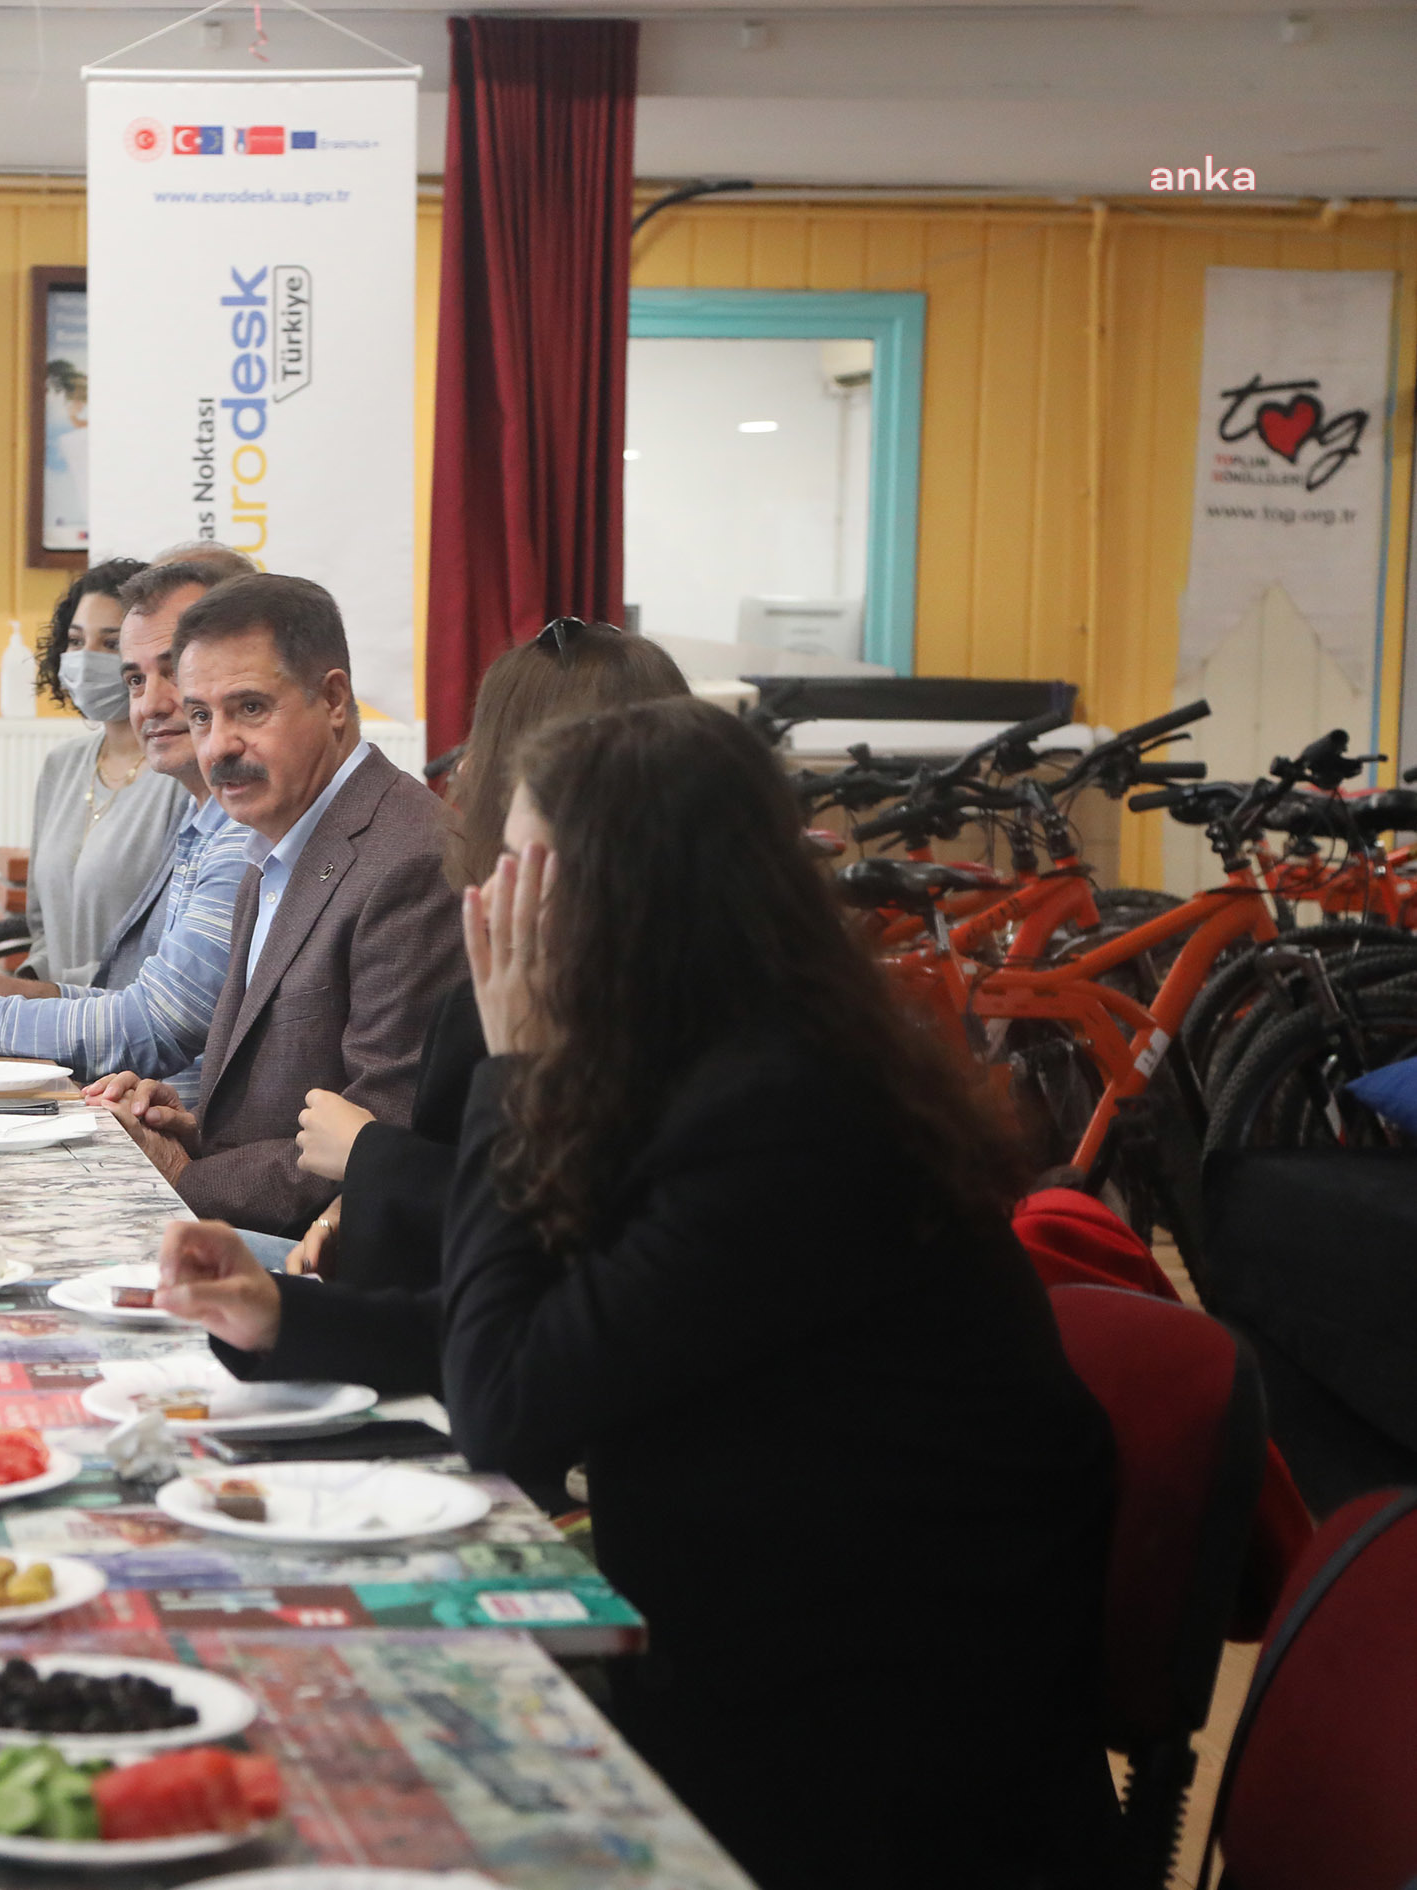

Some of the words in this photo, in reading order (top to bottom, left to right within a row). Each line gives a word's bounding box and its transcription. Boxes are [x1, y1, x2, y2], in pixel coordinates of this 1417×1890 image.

[153, 189, 351, 206] www.eurodesk.ua.gov.tr
[281, 276, 310, 381] Türkiye
[192, 397, 215, 503] Noktası
[221, 265, 268, 573] urodesk
[1206, 504, 1357, 525] www.tog.org.tr
